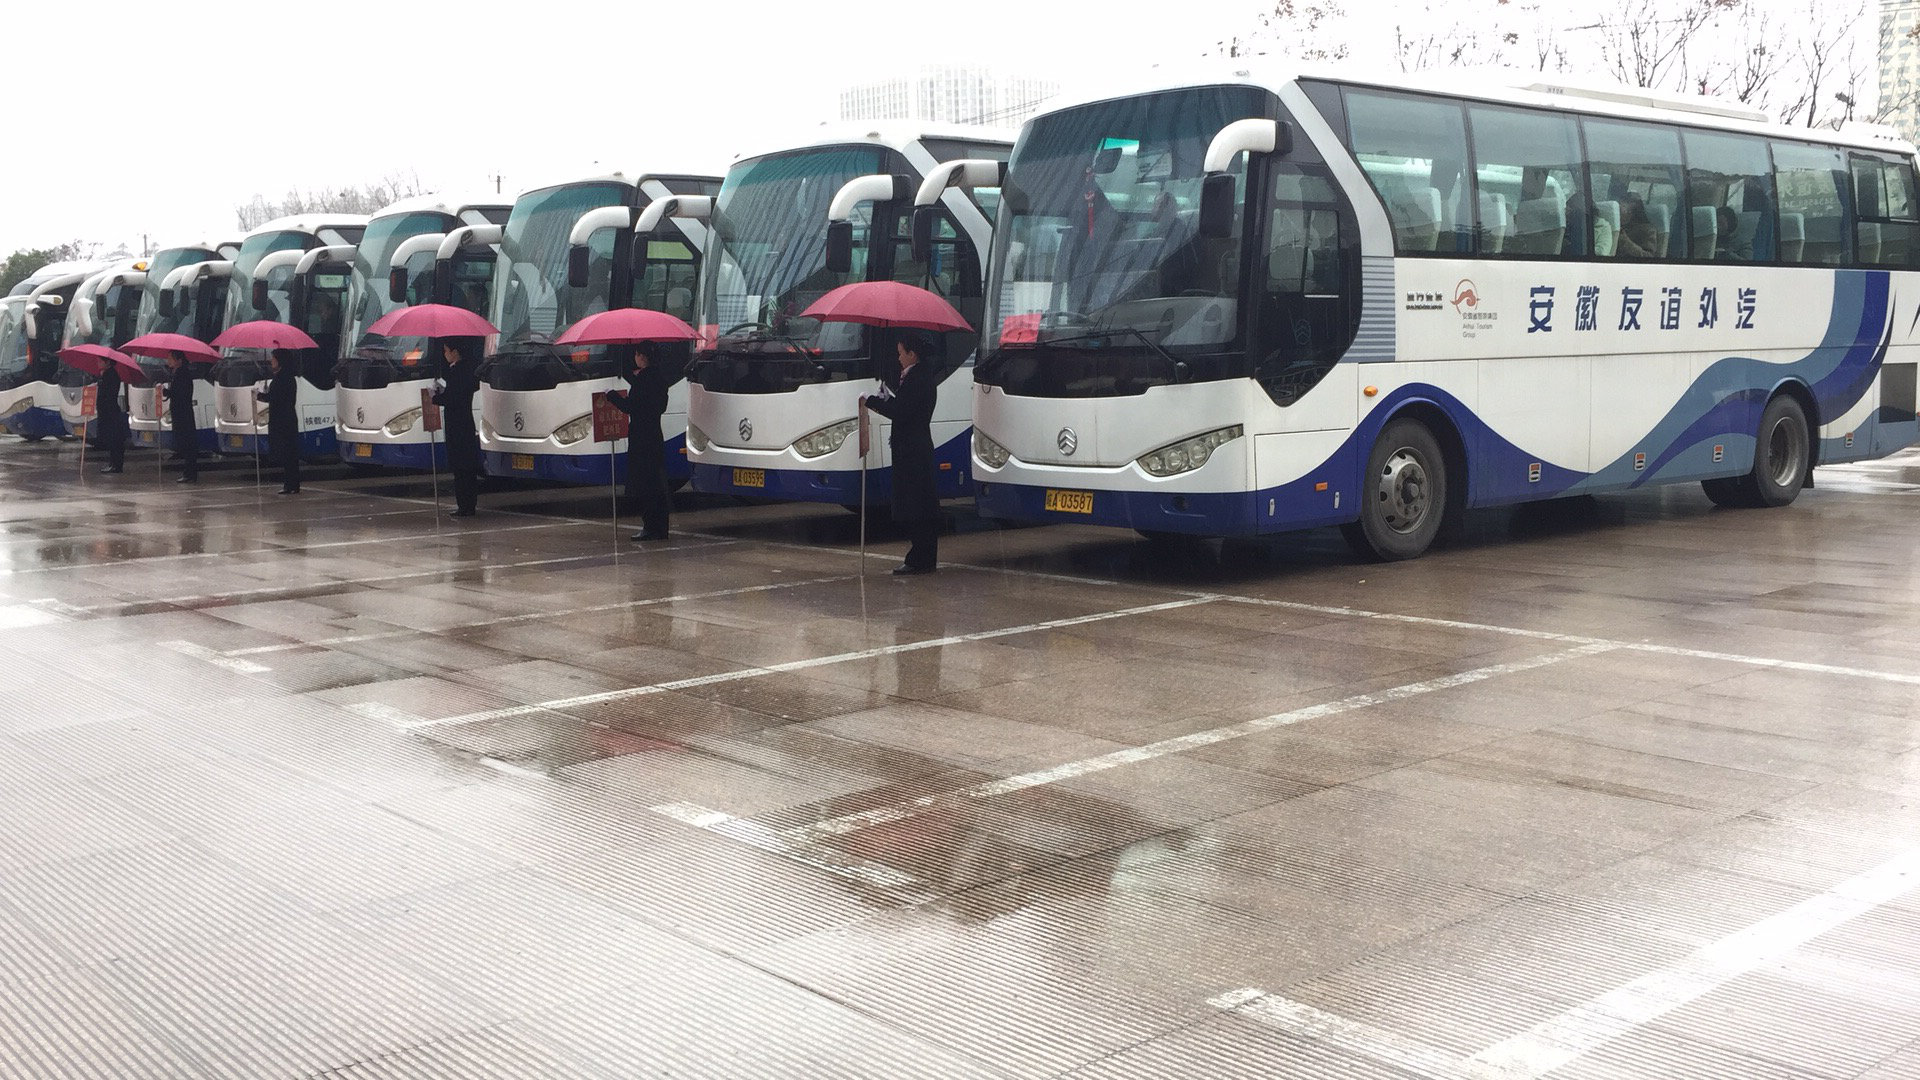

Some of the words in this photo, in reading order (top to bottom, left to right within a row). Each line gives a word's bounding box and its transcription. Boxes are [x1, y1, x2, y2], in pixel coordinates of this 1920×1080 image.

[1527, 285, 1757, 333] 安徽友谊外汽
[1462, 331, 1476, 339] Group
